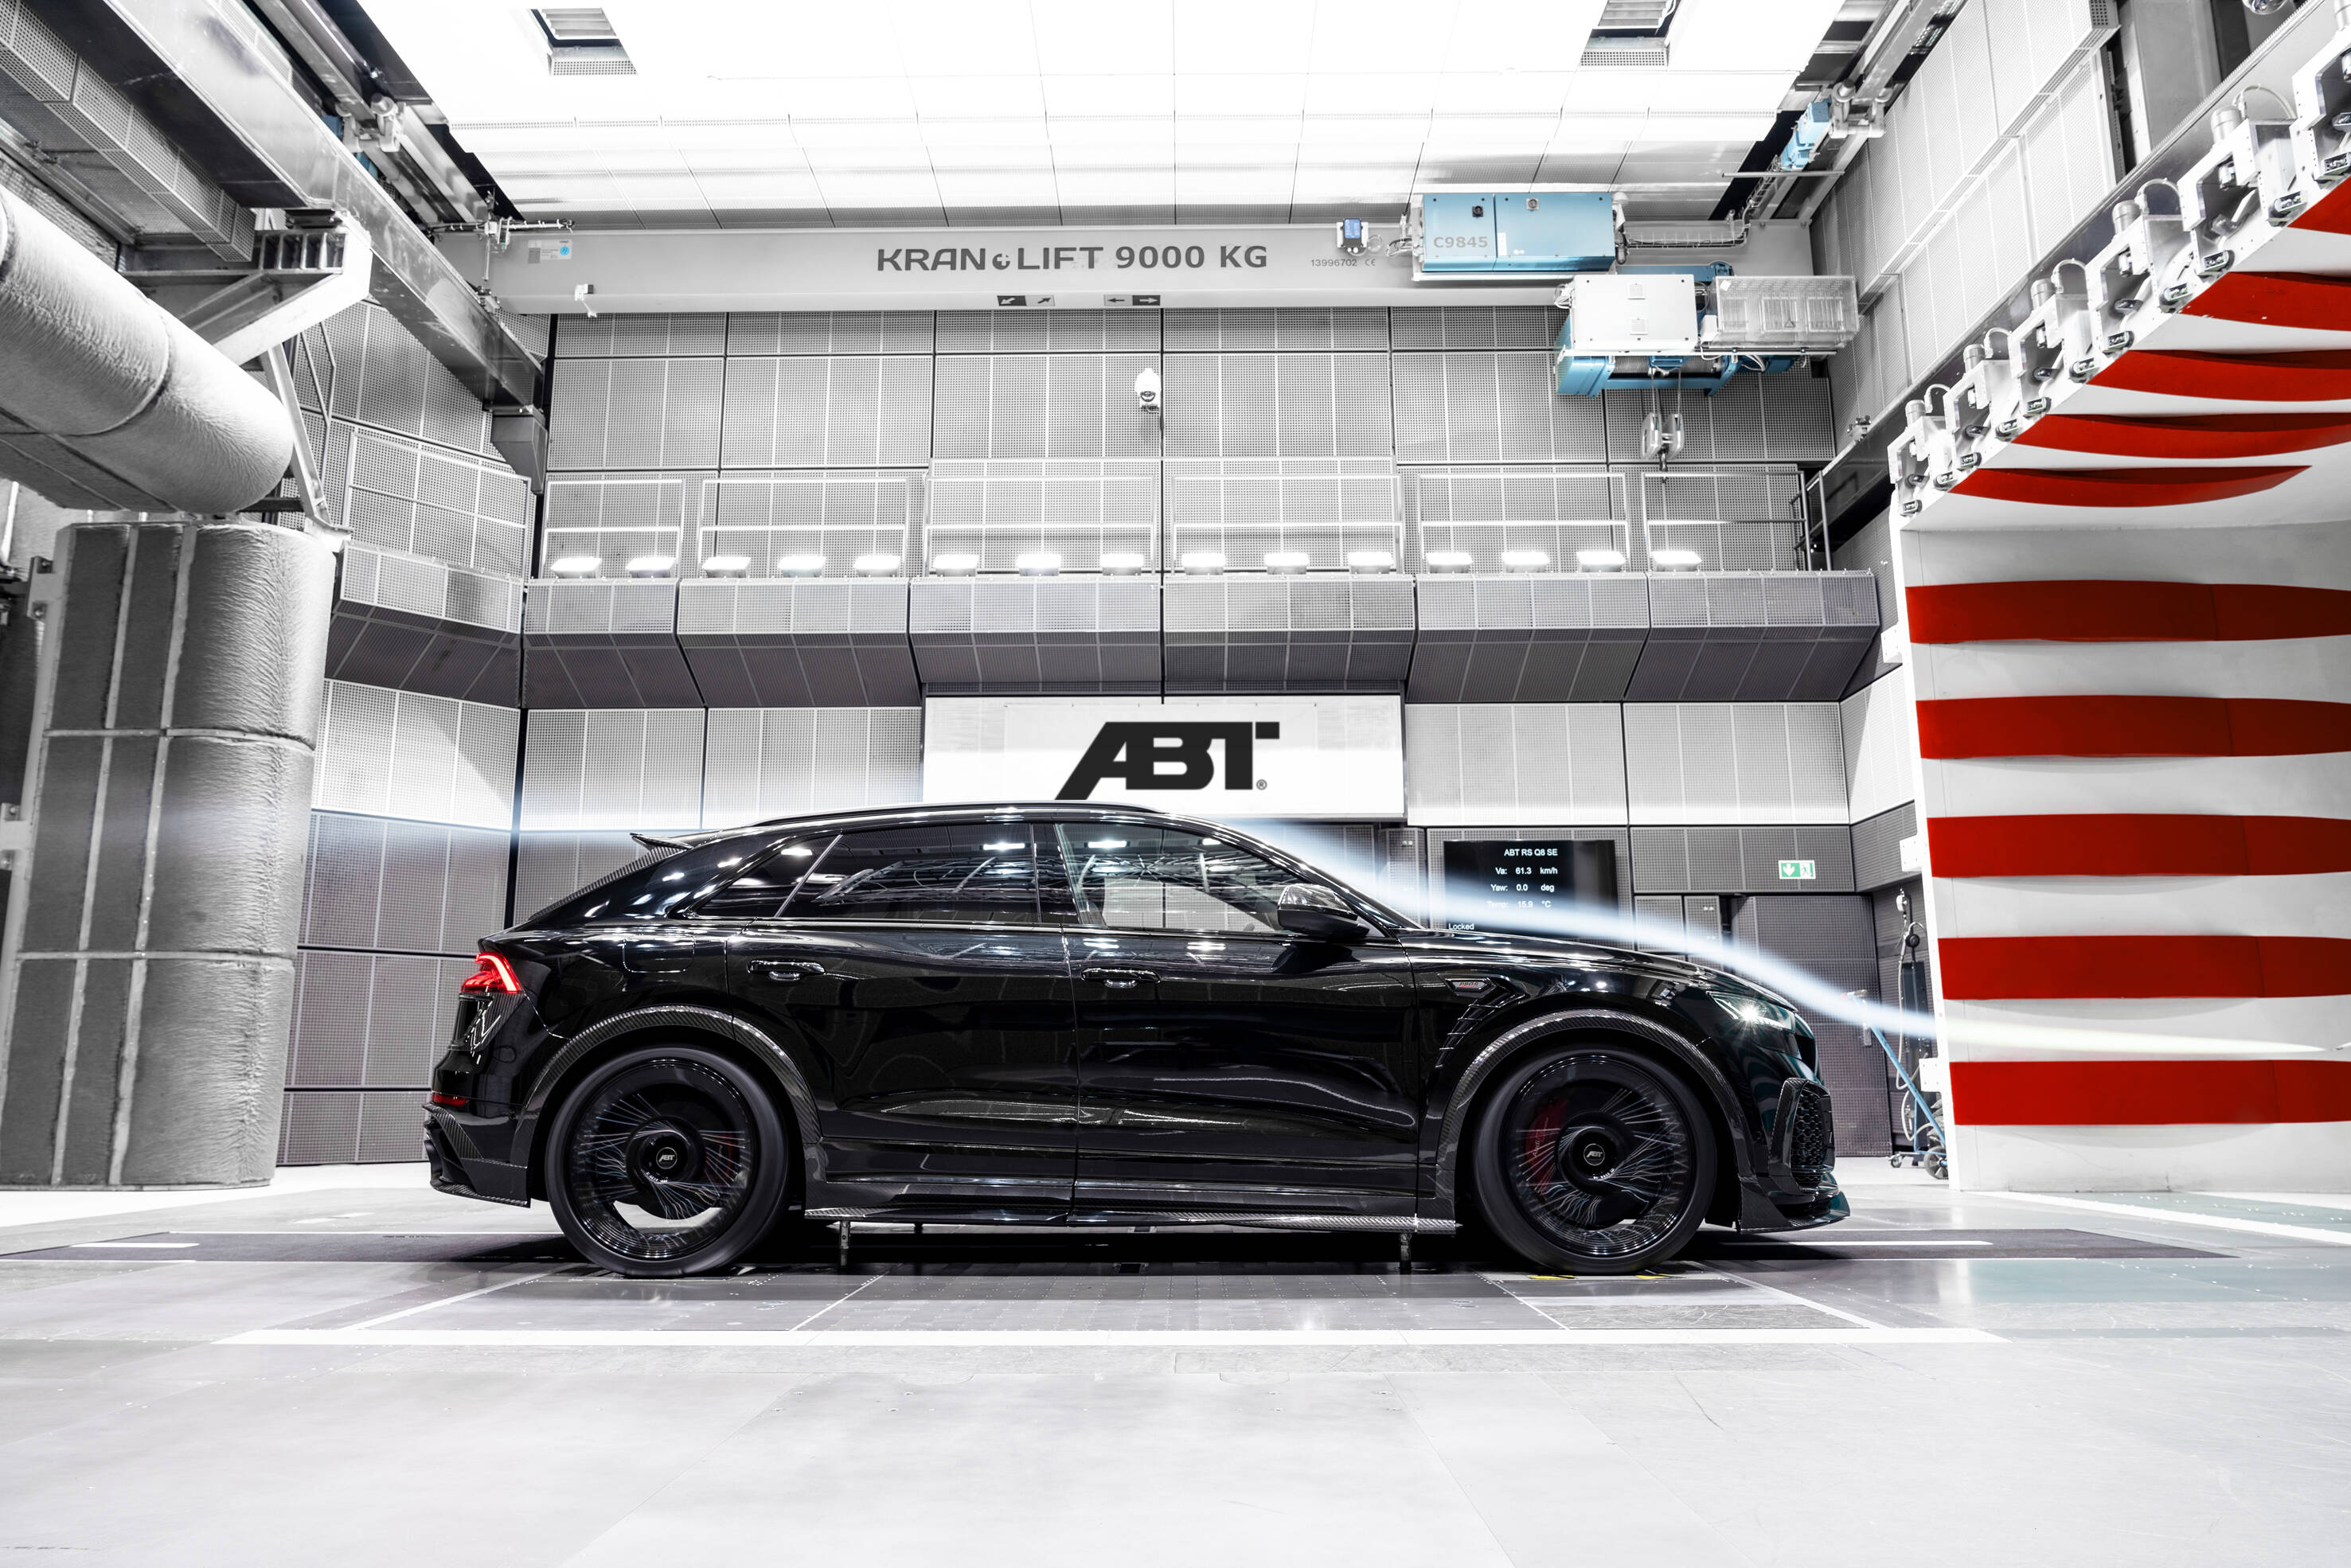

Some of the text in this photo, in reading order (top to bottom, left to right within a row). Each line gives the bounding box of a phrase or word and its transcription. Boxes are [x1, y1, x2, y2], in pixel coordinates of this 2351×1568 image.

[1433, 236, 1488, 248] C9845
[877, 245, 1267, 271] KRAN LIFT 9000 KG
[1311, 258, 1357, 267] 13996702
[1541, 883, 1555, 892] deg
